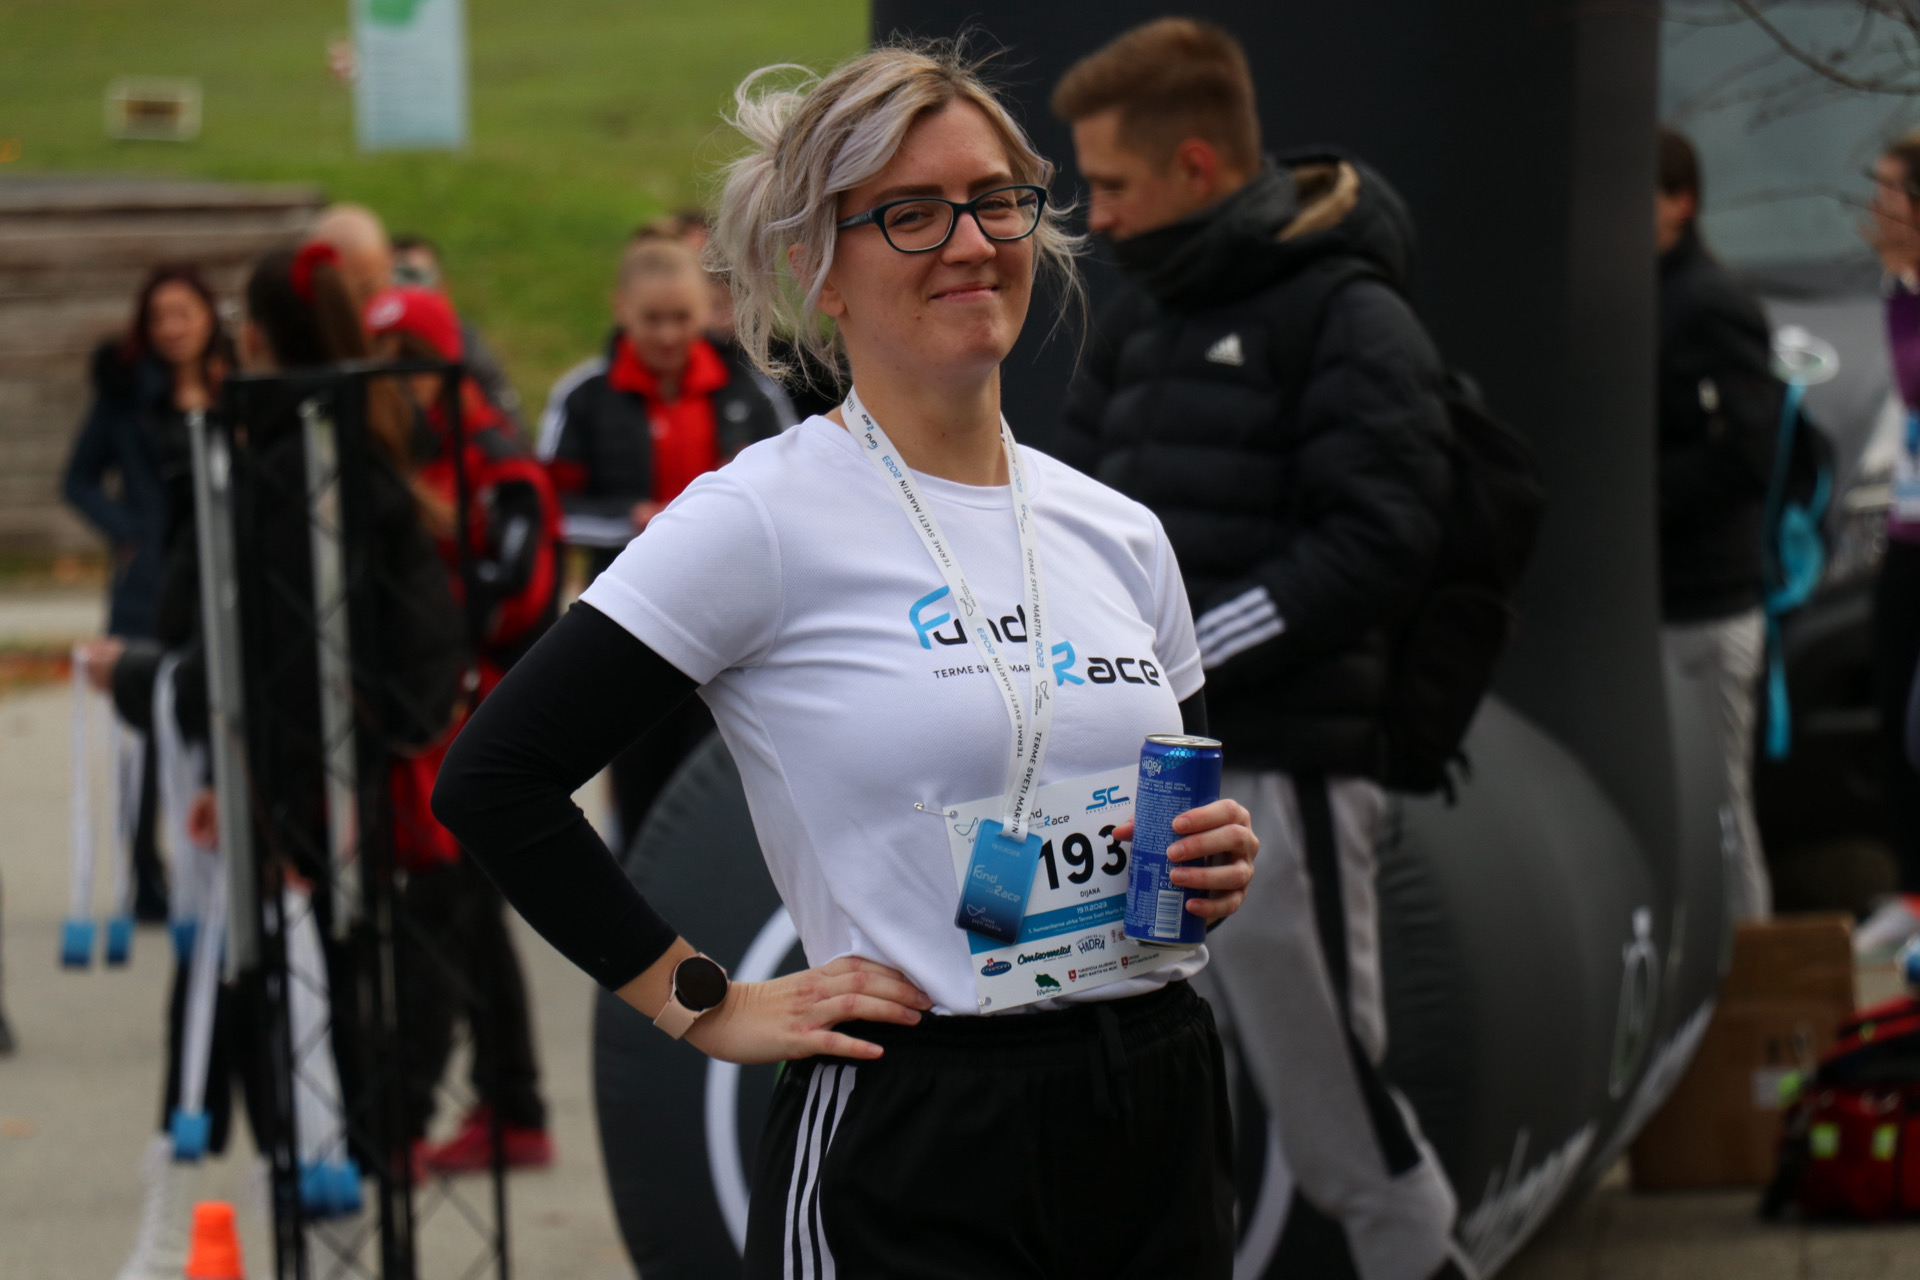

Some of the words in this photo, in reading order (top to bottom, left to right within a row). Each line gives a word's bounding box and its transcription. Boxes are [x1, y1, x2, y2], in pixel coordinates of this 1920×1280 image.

[881, 455, 903, 478] 2023
[899, 479, 922, 513] MARTIN
[917, 514, 936, 538] SVETI
[931, 539, 952, 568] TERME
[1026, 548, 1036, 577] TERME
[1029, 577, 1039, 603] SVETI
[1032, 603, 1042, 638] MARTIN
[977, 627, 996, 655] 2023
[1035, 639, 1045, 669] 2023
[933, 665, 975, 679] TERME
[1009, 664, 1031, 673] MAR
[993, 657, 1013, 693] MARTIN
[1010, 693, 1022, 721] SVETI
[1029, 731, 1042, 765] TERME
[1020, 766, 1034, 794] SVETI
[1085, 785, 1130, 811] SC
[1011, 795, 1025, 834] MARTIN
[1038, 824, 1127, 891] 193
[1080, 887, 1101, 898] DIJANA
